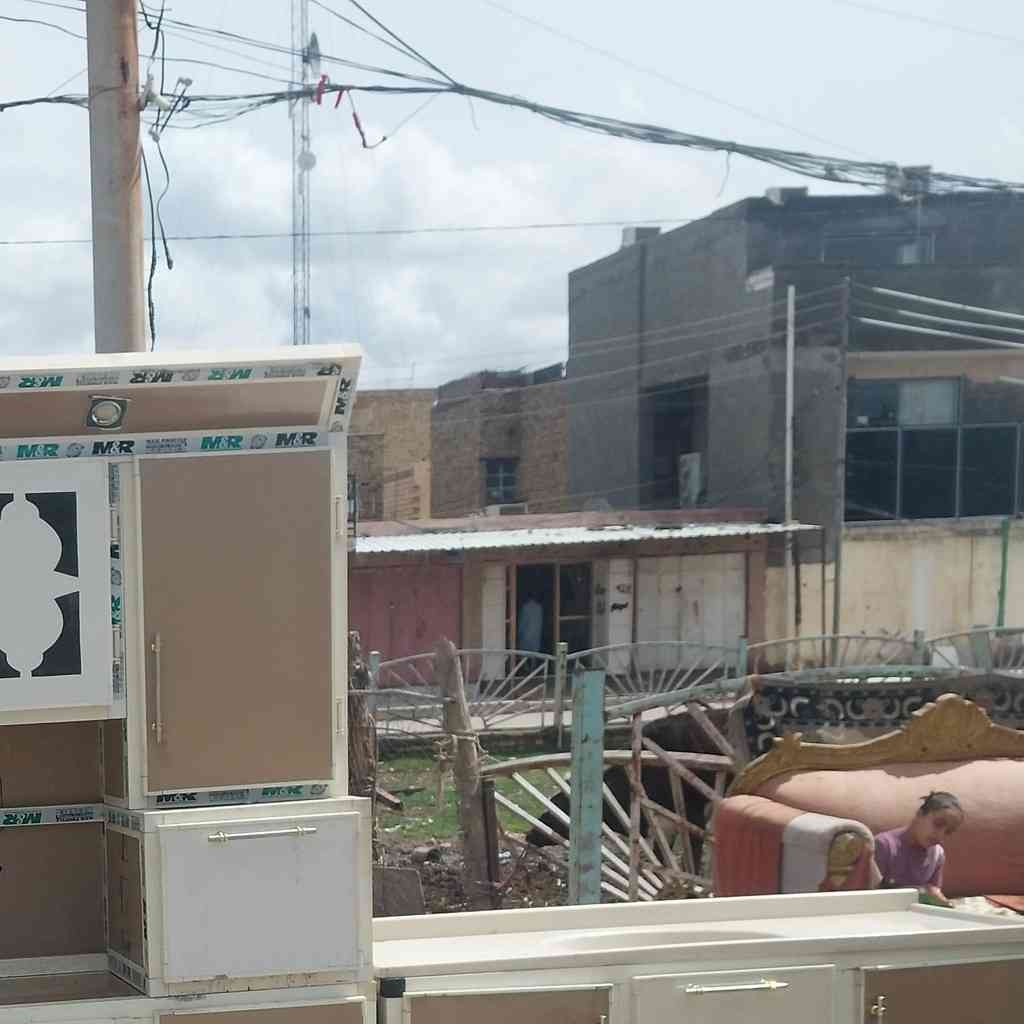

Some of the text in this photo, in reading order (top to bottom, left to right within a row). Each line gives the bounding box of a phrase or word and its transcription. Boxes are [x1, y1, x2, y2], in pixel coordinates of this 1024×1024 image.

[201, 435, 243, 449] M&R
[276, 432, 318, 446] M&R
[16, 444, 59, 457] M&R
[92, 441, 135, 454] M&R
[3, 812, 42, 825] M&R
